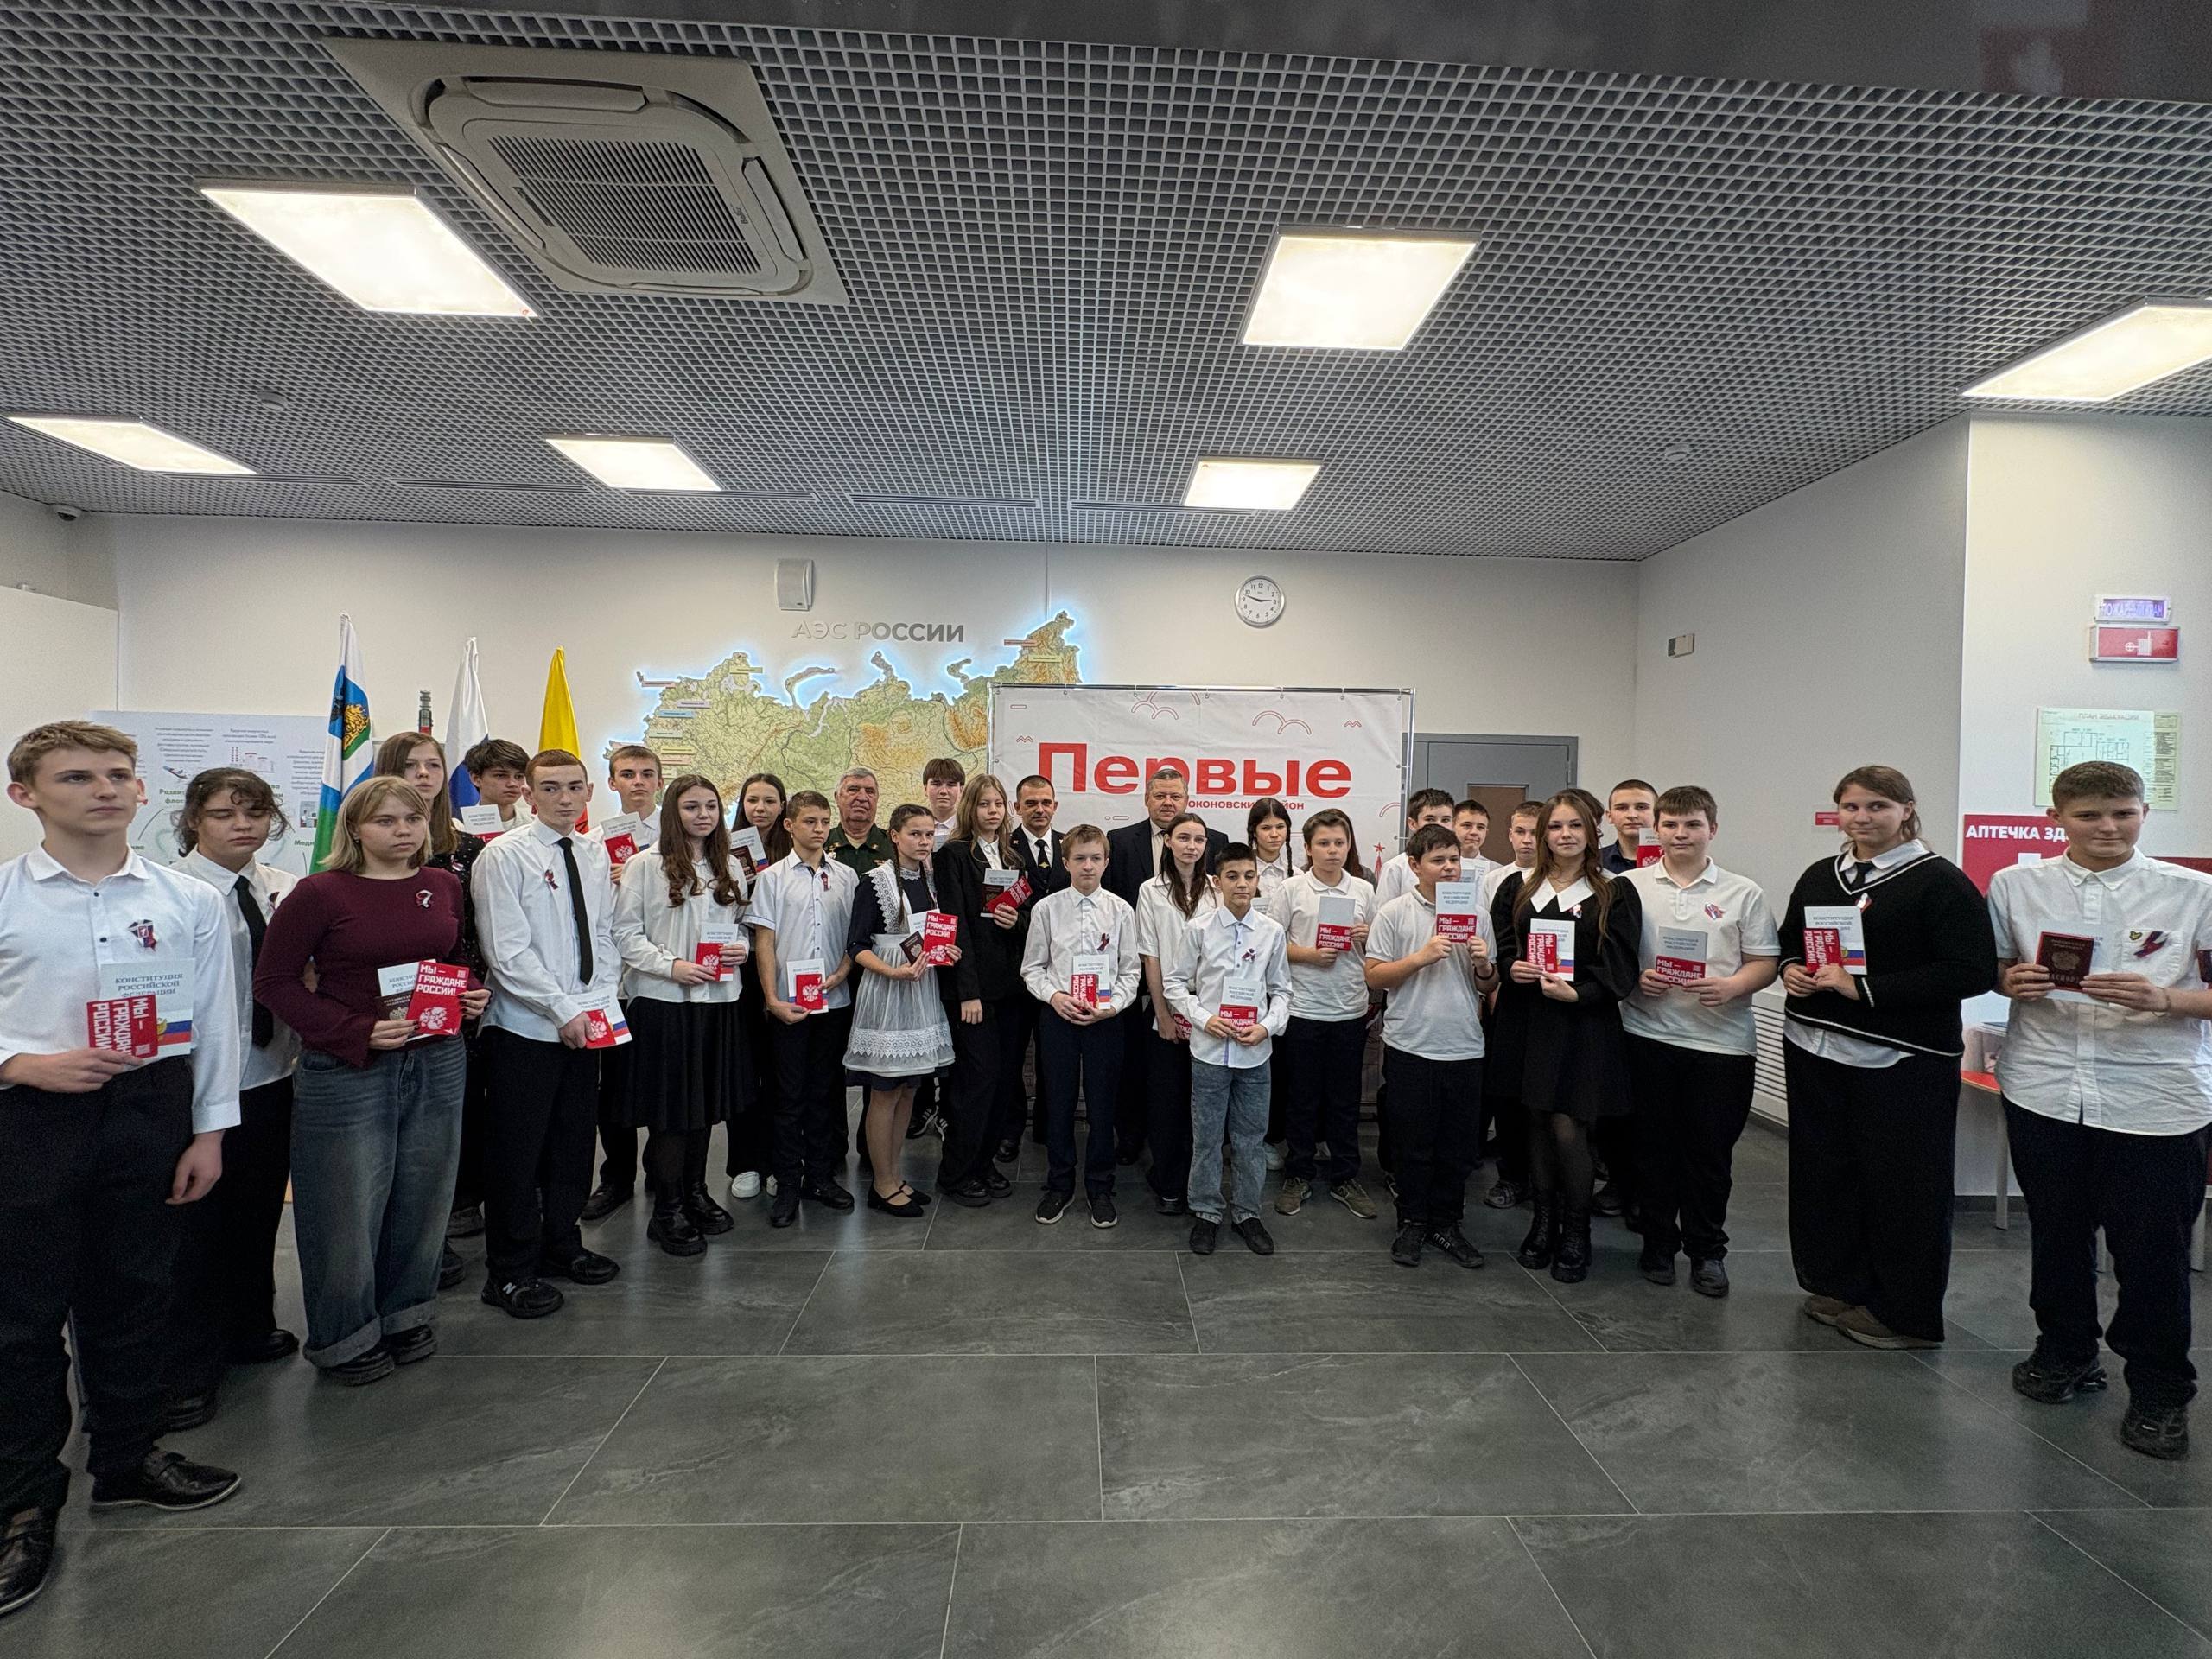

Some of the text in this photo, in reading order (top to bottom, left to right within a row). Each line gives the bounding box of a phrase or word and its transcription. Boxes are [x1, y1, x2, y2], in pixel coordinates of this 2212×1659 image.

[791, 620, 964, 643] АЭС РОССИИ
[1039, 742, 1351, 798] Первые
[1966, 825, 2069, 842] АПТЕЧКА ЗД
[1823, 931, 1835, 945] МЫ
[1813, 931, 1827, 967] ГРАЖДАН
[420, 964, 436, 975] МЫ
[1656, 959, 1673, 968] МЫ
[115, 973, 183, 983] КОНСТИТУЦИЯ
[1656, 966, 1702, 980] ГРАЖДАНЕ
[118, 981, 180, 991] РОССИЙСКОЙ
[418, 974, 467, 988] ГРАЖДАНЕ
[416, 984, 456, 996] РОССИИ!
[132, 997, 149, 1019] МЫ
[92, 1002, 112, 1050] РОССИИ
[112, 1000, 133, 1055] ГРАЖДАН
